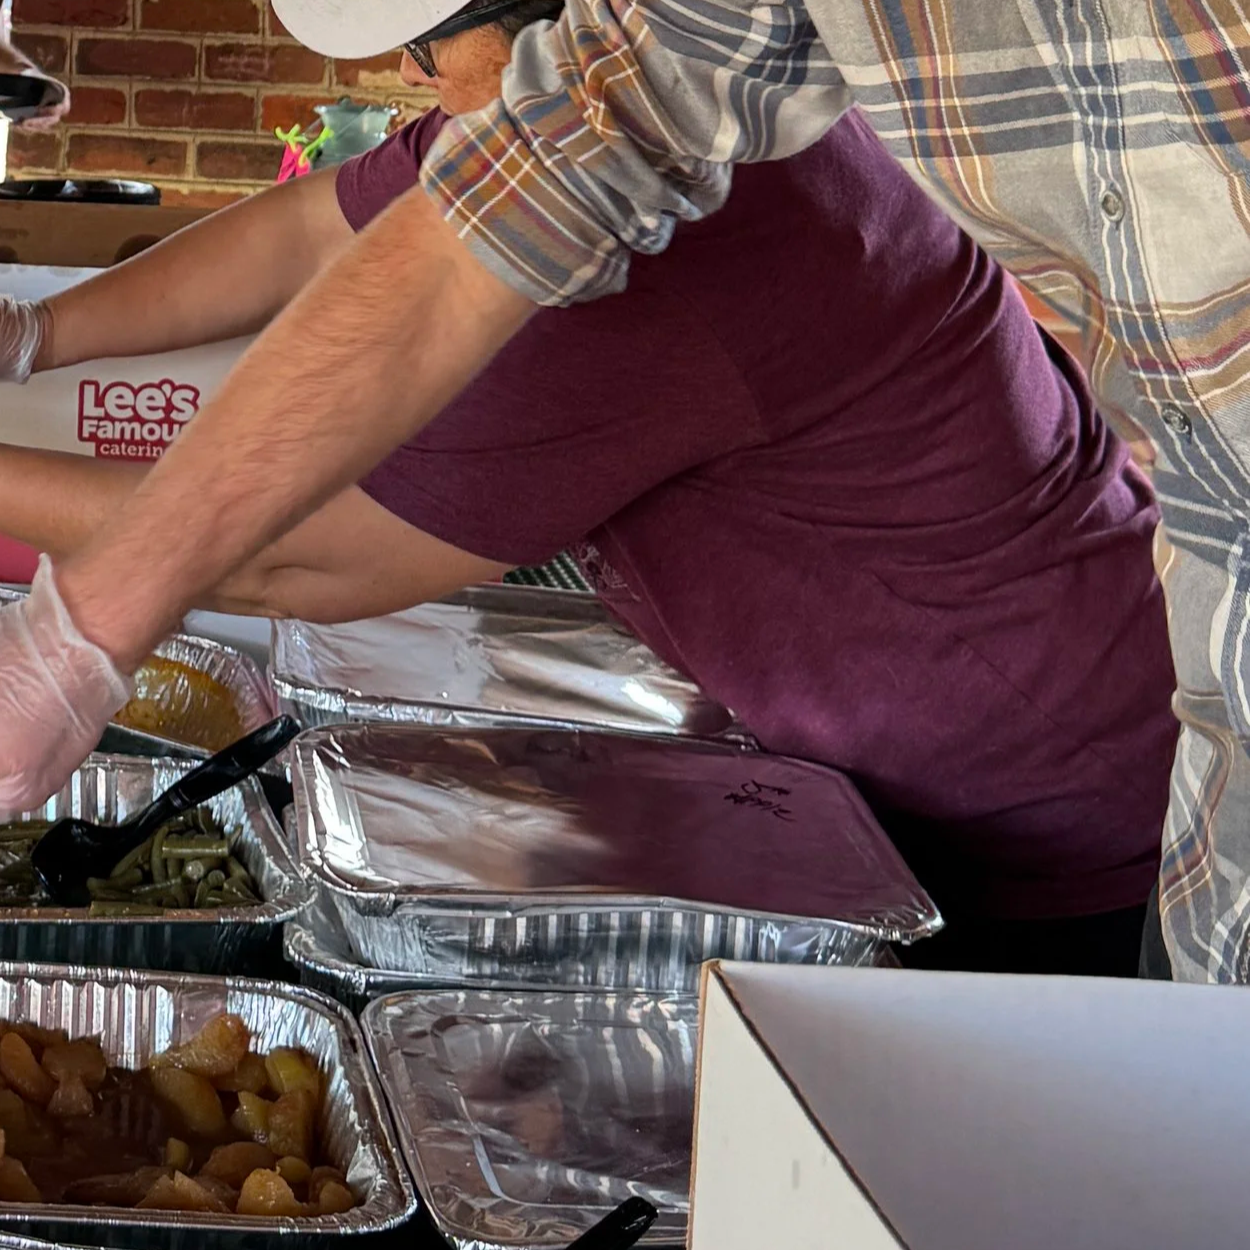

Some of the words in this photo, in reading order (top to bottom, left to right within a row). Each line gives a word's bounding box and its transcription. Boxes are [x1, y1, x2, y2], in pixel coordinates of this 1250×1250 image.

[81, 381, 197, 422] Lee's
[81, 419, 180, 442] Famou
[99, 442, 164, 457] caterin
